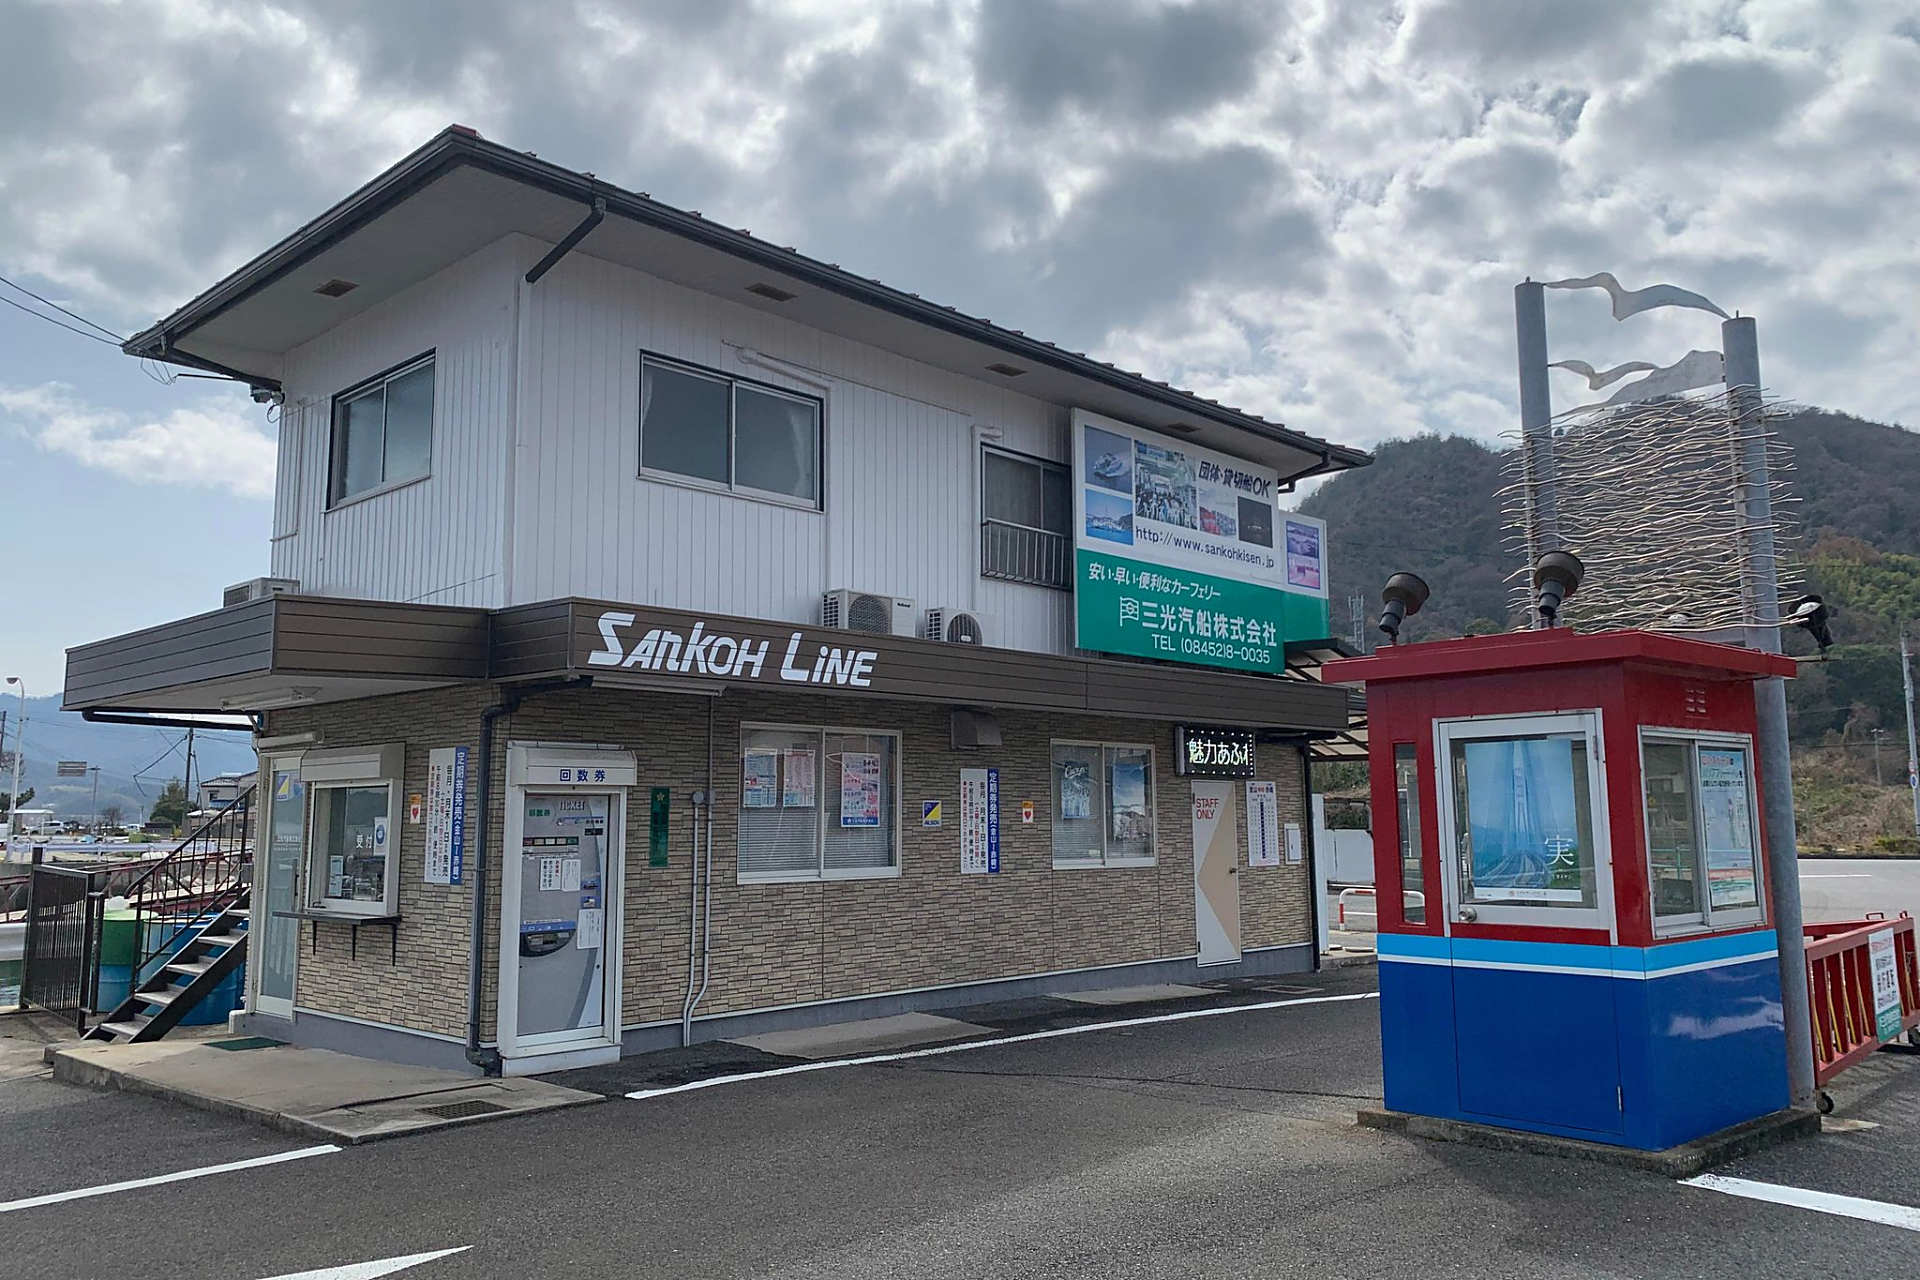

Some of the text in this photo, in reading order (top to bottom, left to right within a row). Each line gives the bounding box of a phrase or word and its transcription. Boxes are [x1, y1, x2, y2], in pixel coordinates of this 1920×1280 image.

[1142, 602, 1277, 647] 三光汽船株式会社
[1151, 634, 1176, 651] TEL
[560, 769, 606, 782] 回数券
[1196, 798, 1219, 808] STAFF
[1197, 809, 1215, 820] ONLY
[1544, 834, 1575, 866] 実
